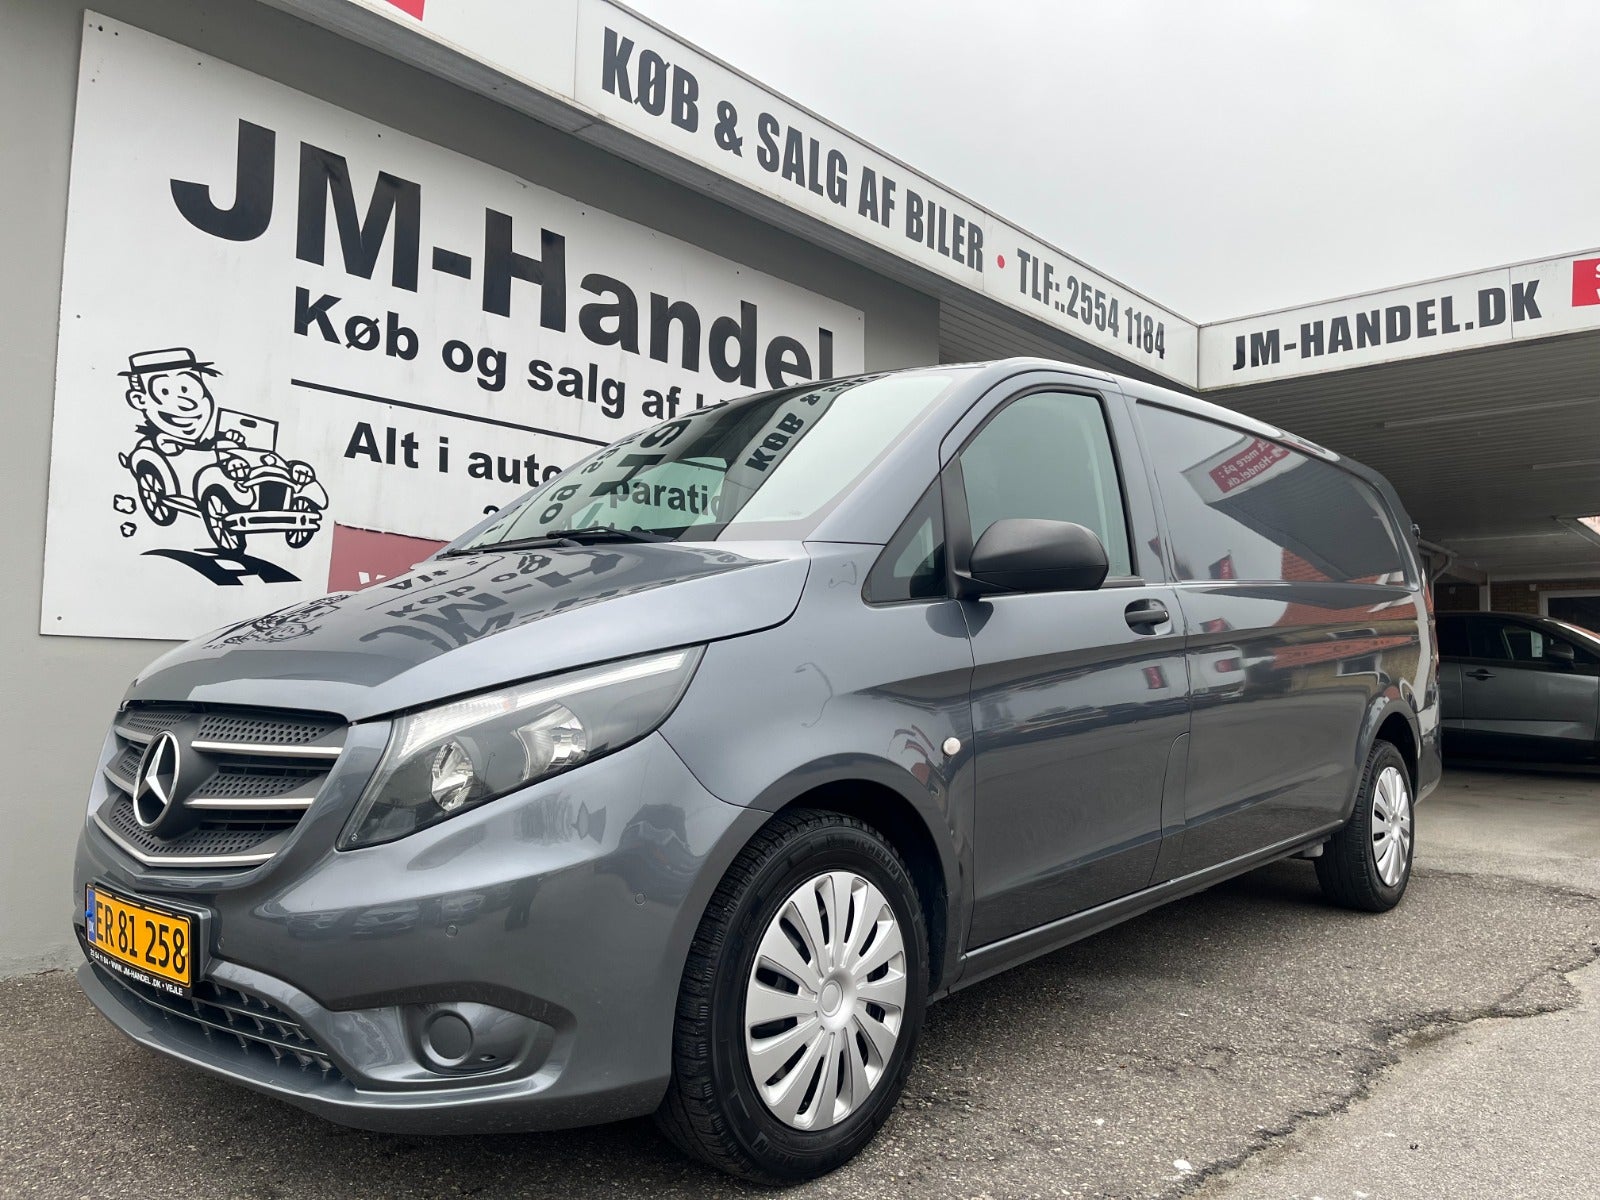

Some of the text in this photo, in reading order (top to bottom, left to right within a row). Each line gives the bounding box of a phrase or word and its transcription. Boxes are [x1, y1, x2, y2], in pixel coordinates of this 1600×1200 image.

[602, 26, 699, 134] KØB
[714, 100, 744, 158] &
[756, 112, 848, 219] SALG
[857, 165, 896, 229] AF
[905, 188, 984, 273] BILER
[1124, 306, 1166, 360] 1184
[169, 118, 834, 391] JM-Handel
[293, 286, 682, 420] Køb og salg af
[1232, 279, 1542, 371] JM-HANDEL.DK
[343, 421, 419, 469] Alt
[438, 435, 449, 473] i
[96, 900, 186, 975] ER 81 258
